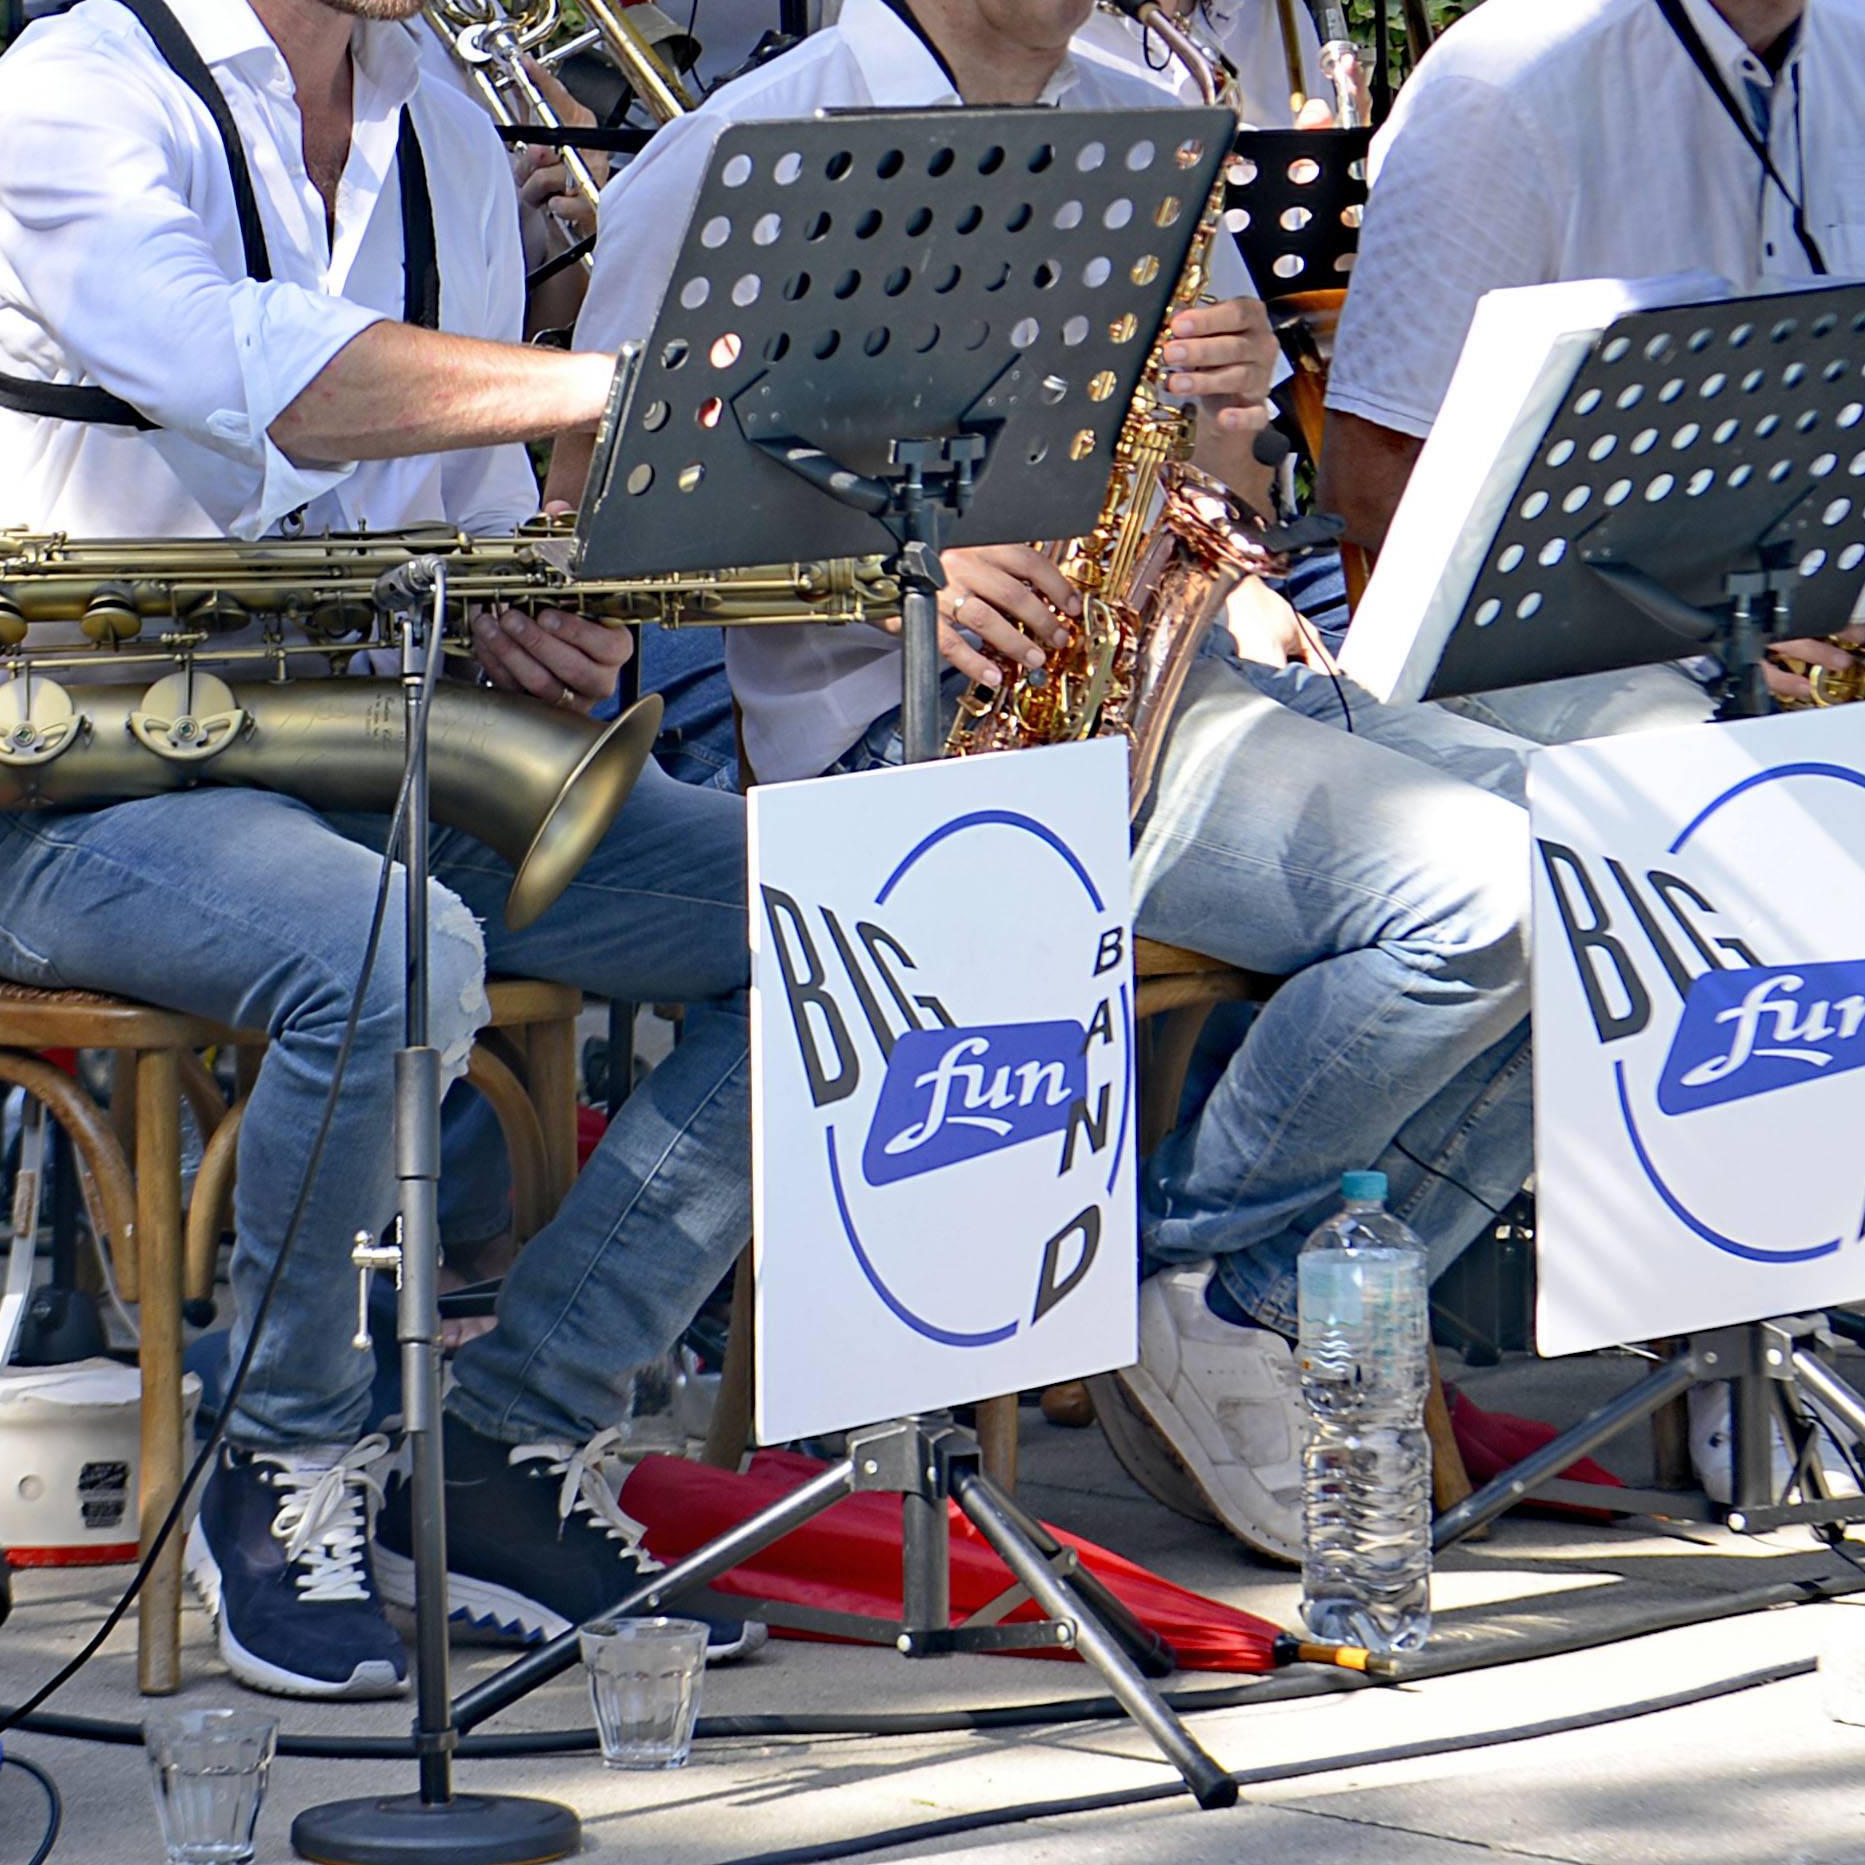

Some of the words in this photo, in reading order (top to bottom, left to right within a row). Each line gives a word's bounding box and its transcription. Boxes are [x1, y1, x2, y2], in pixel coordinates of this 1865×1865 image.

[760, 882, 959, 1109] BIG
[1536, 837, 1766, 1044] BIG
[883, 1035, 1073, 1155] fun
[1030, 925, 1125, 1327] BAND
